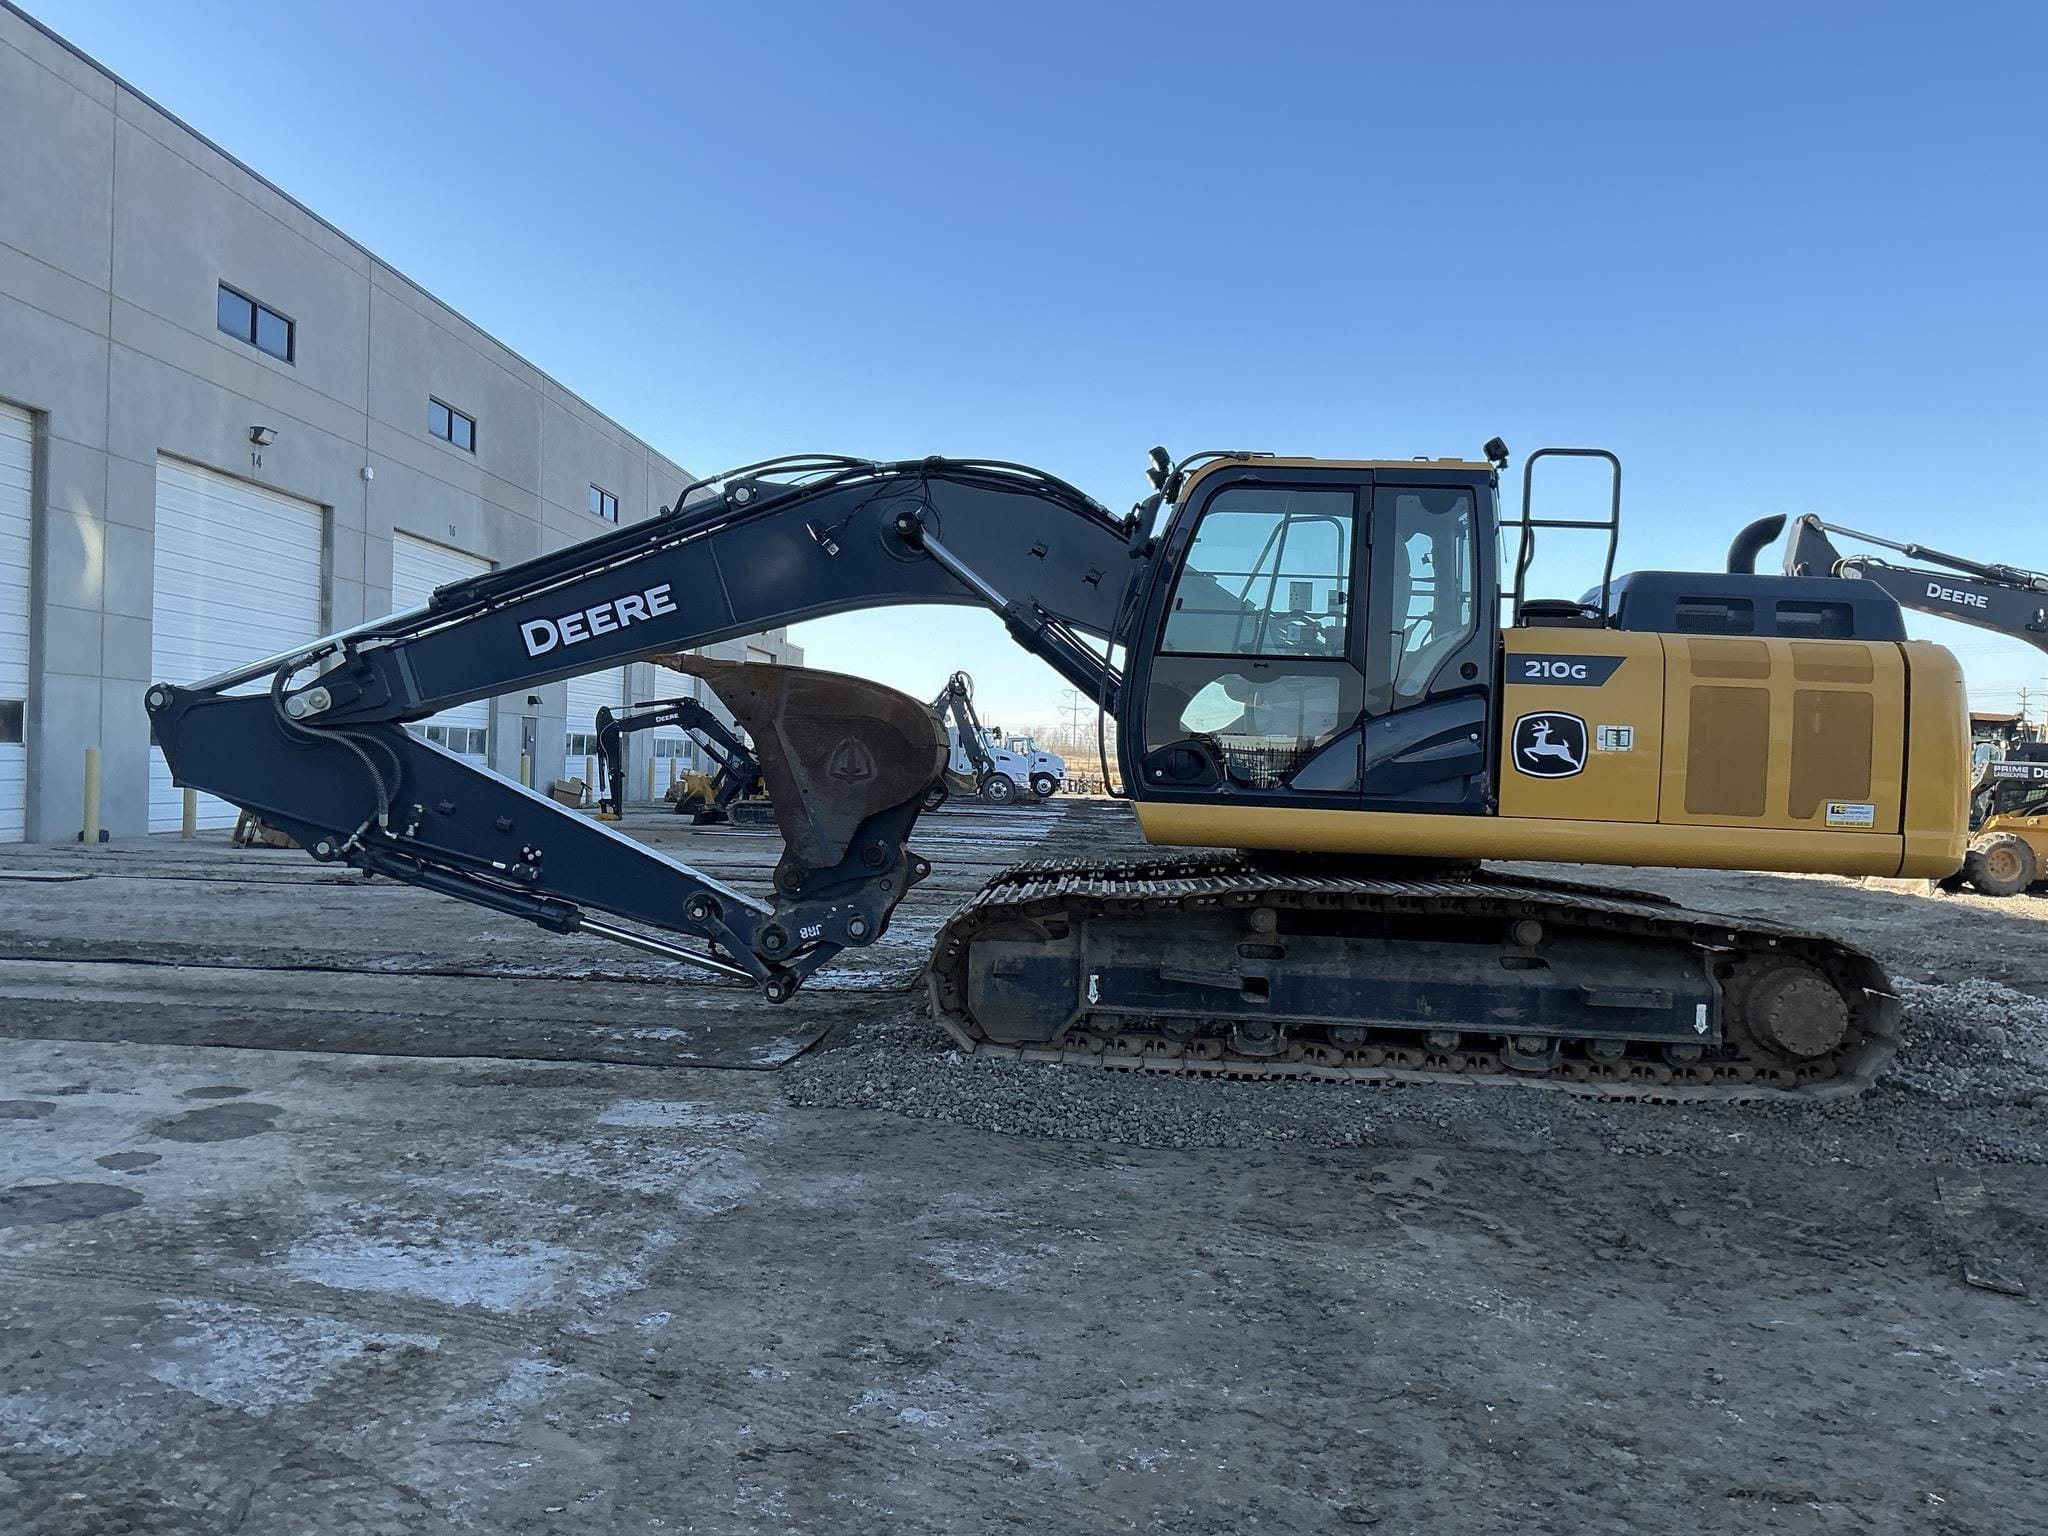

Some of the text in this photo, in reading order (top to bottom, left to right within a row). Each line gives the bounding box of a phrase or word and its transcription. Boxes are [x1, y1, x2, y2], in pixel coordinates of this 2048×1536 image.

[251, 452, 262, 469] 14
[1926, 582, 1989, 609] DEERE
[520, 583, 678, 657] DEERE
[1525, 661, 1587, 679] 210G
[655, 713, 680, 723] DEERE
[1993, 765, 2029, 773] PRIME
